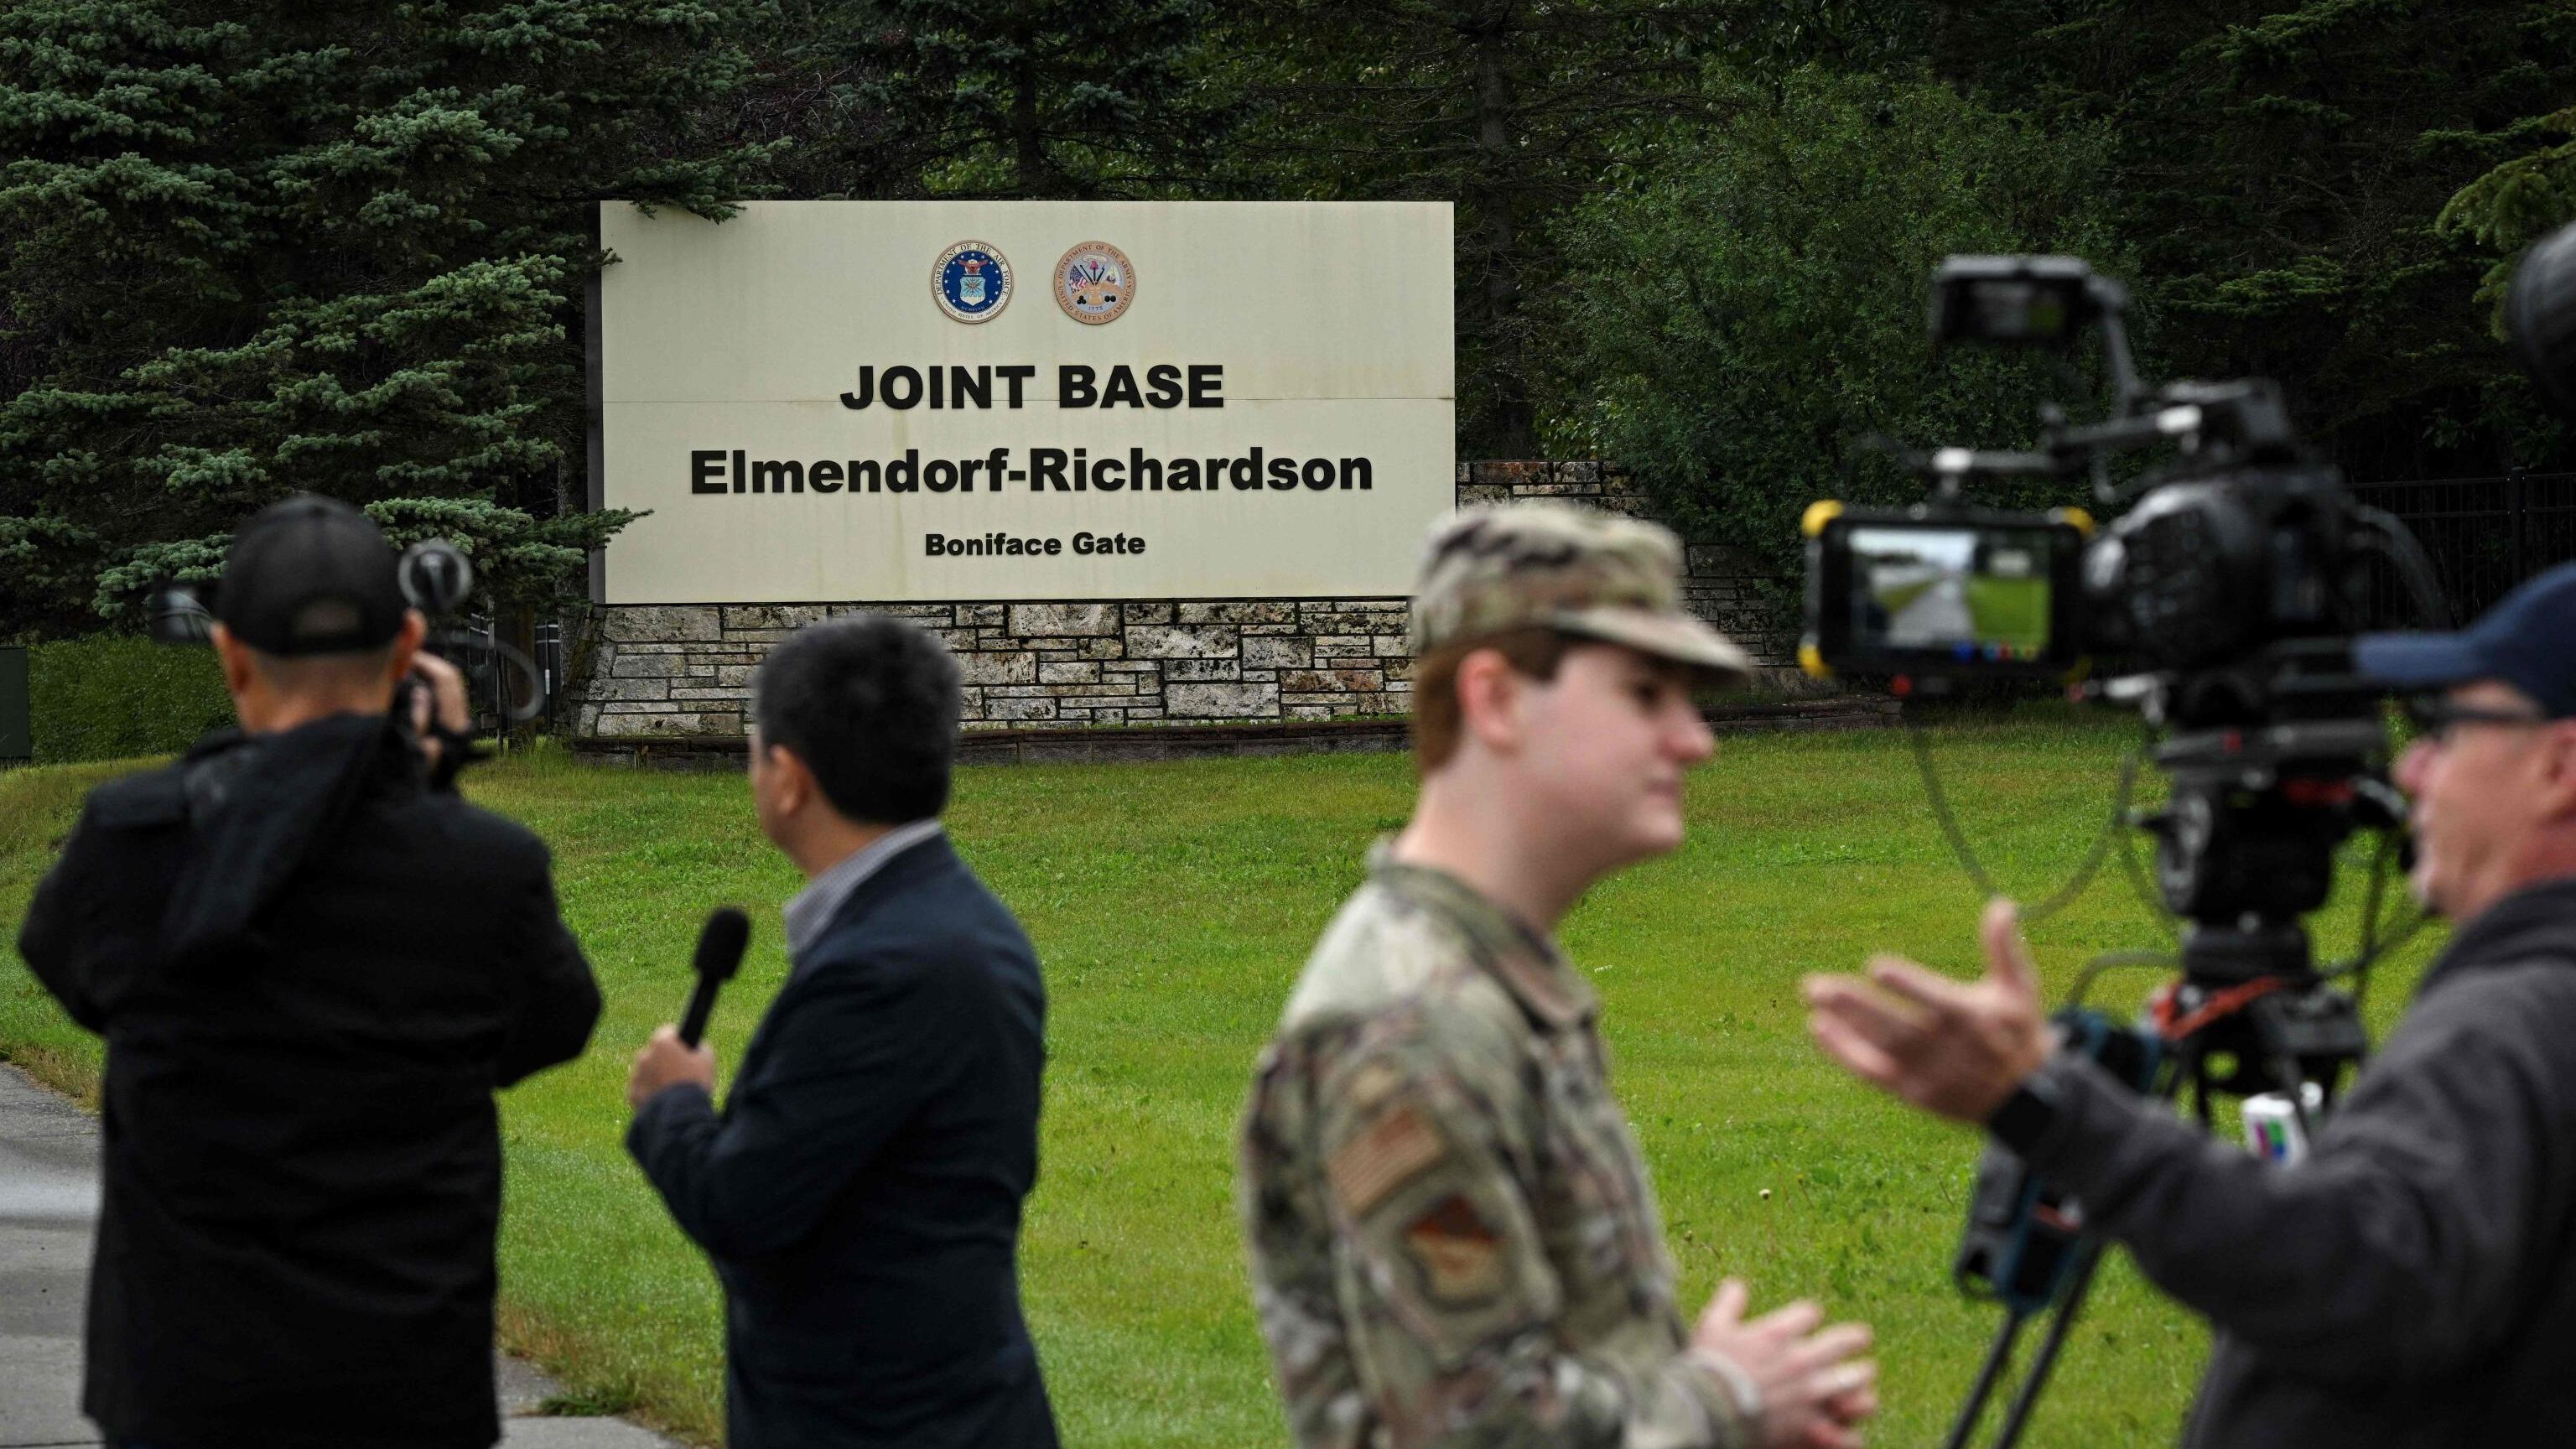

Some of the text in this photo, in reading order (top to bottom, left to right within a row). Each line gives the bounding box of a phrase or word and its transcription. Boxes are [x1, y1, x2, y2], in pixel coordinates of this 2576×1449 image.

[935, 248, 957, 295] DEPARTMENT
[976, 243, 992, 253] THE
[993, 254, 1005, 267] AIR
[1059, 245, 1091, 279] DEPARTMENT
[1108, 247, 1120, 258] THE
[1119, 261, 1132, 279] ARMY
[1057, 286, 1073, 311] UNITED
[1074, 310, 1102, 320] STATES
[1114, 284, 1132, 314] AMERICA
[839, 364, 1224, 411] JOINT BASE
[690, 446, 1373, 495] Elmendorf-Richardson
[925, 532, 1145, 557] Boniface Gate
